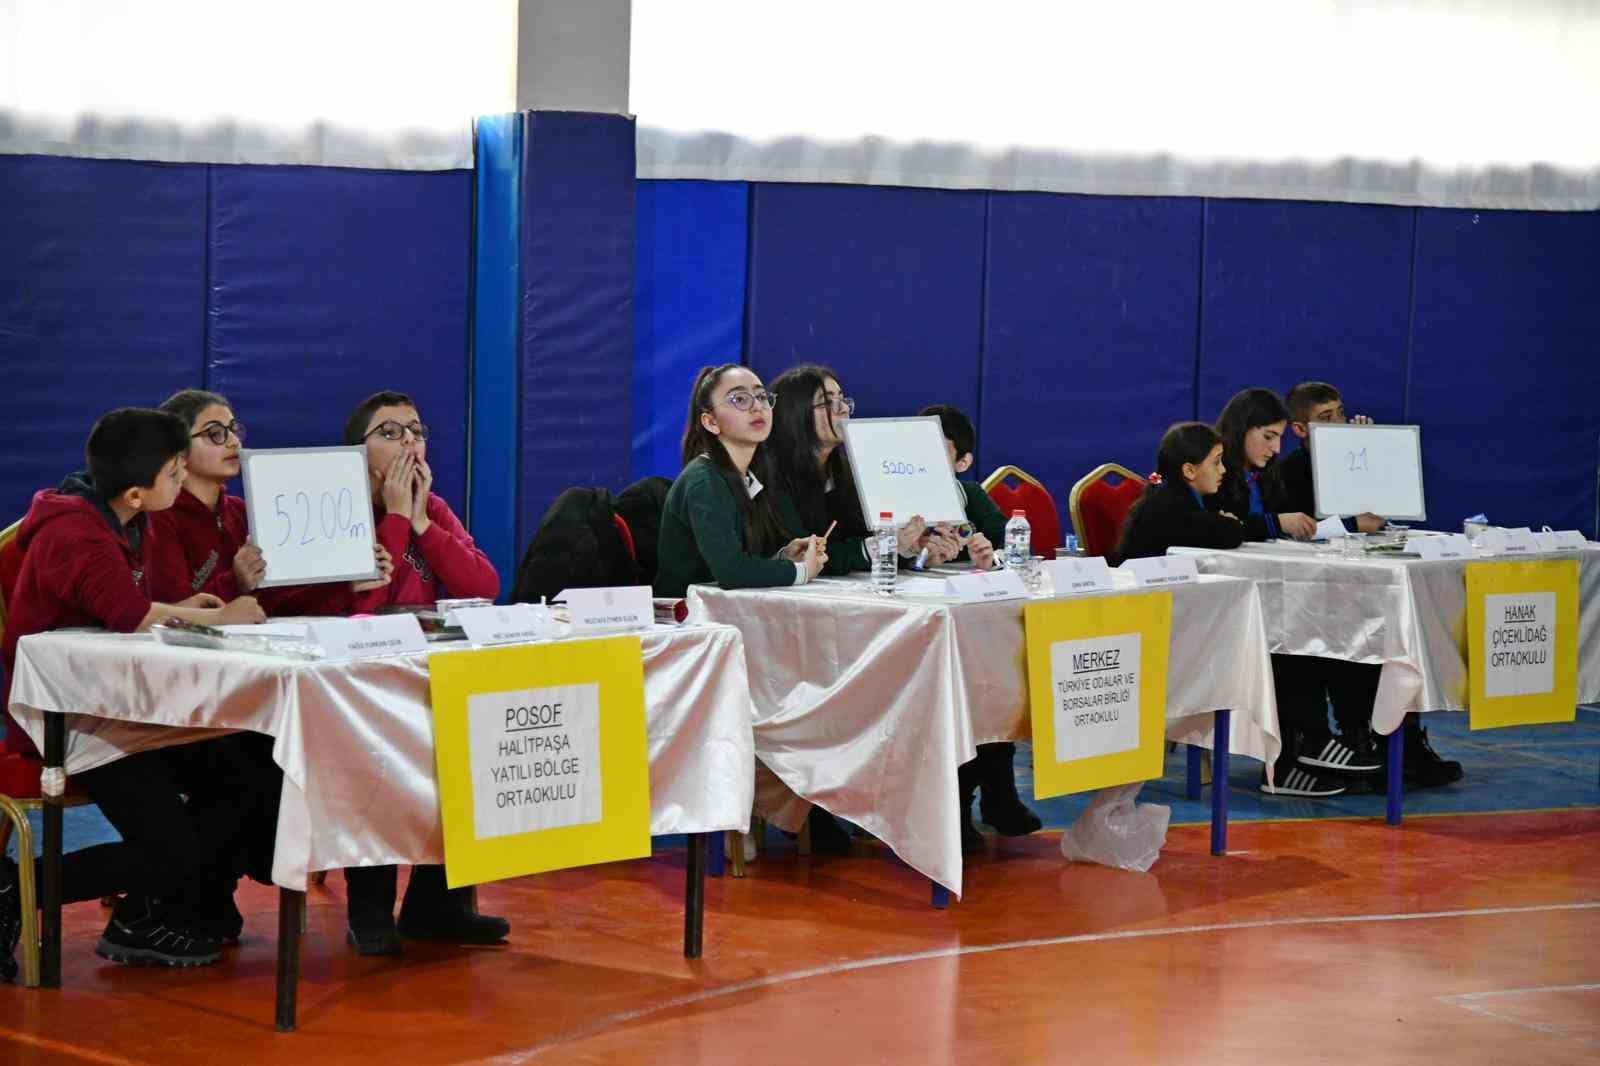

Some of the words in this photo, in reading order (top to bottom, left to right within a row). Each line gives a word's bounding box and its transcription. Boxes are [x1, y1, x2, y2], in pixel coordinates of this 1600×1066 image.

[881, 460, 913, 475] 5200
[1504, 604, 1536, 620] HANAK
[1492, 624, 1547, 648] ÇİÇEKLİDAĞ
[1072, 649, 1120, 671] MERKEZ
[1491, 650, 1547, 668] ORTAOKULU
[1057, 678, 1091, 694] TÜRKİYE
[1092, 672, 1123, 690] ODALAR
[1123, 671, 1136, 685] VE
[1063, 694, 1103, 712] BORSALAR
[505, 703, 563, 728] POSOF
[1074, 709, 1120, 727] ORTAOKULU
[498, 733, 571, 757] HALİTPAŞA
[491, 763, 533, 784] YATILI
[533, 756, 581, 779] BÖLGE
[496, 783, 577, 809] ORTAOKULU
